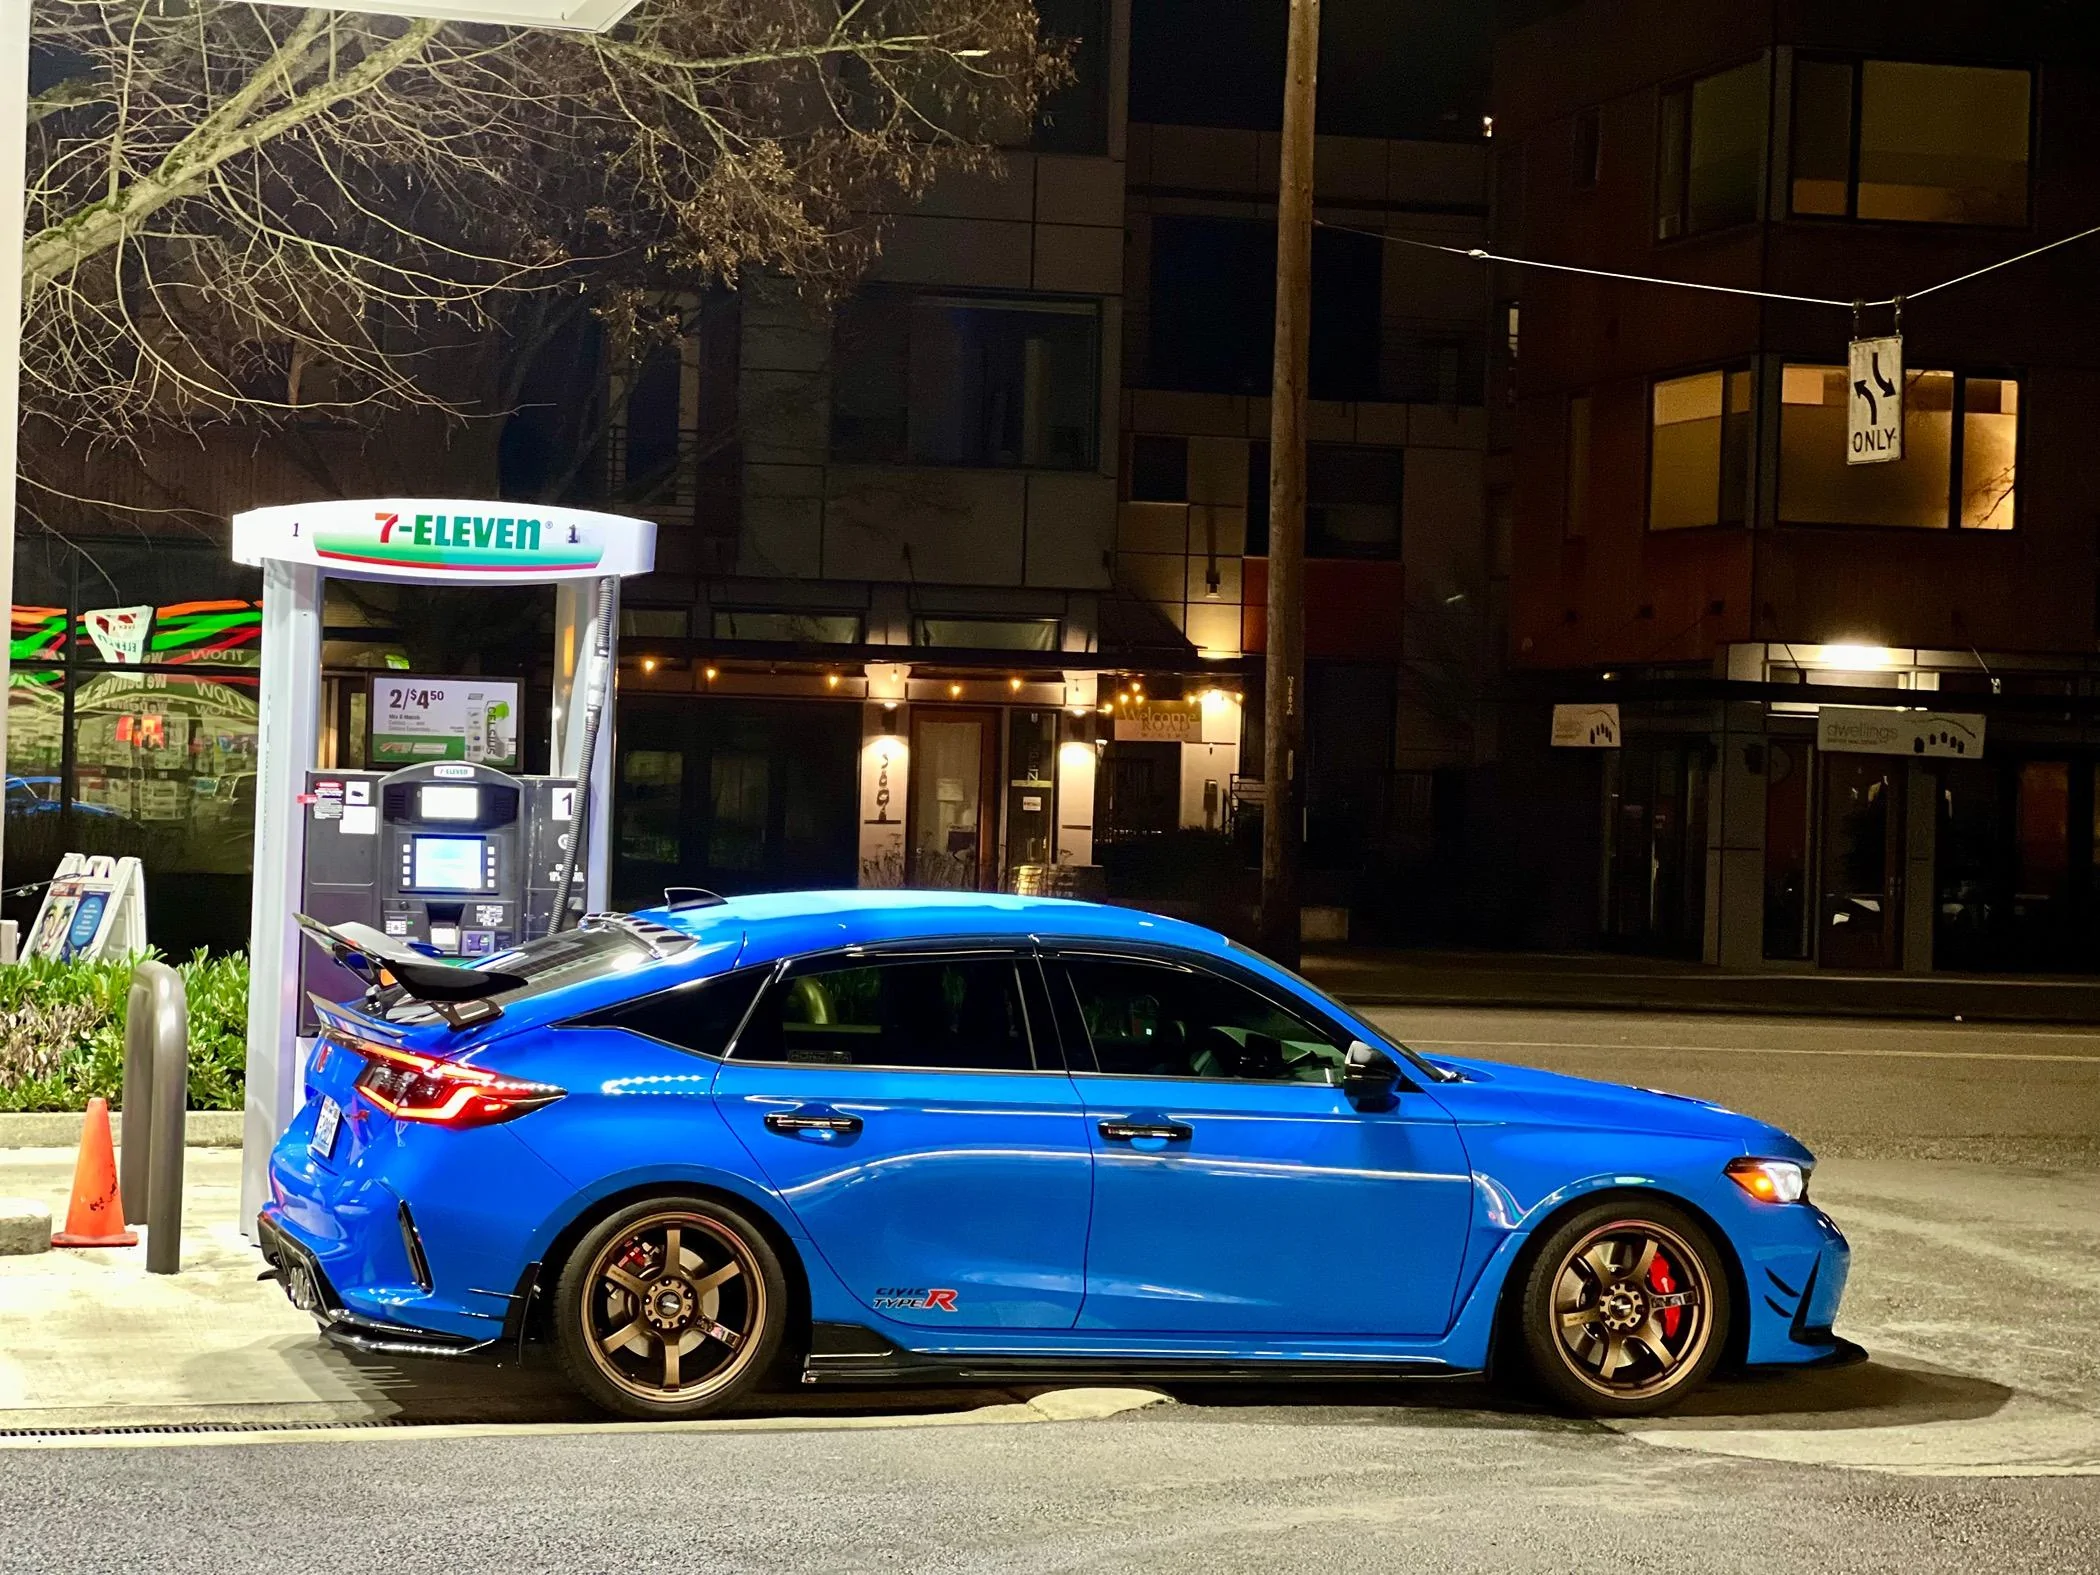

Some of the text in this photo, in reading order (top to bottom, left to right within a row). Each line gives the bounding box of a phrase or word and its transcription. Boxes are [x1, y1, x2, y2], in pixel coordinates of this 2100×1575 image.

[1853, 428, 1896, 453] ONLY
[567, 524, 579, 543] 1
[1121, 706, 1196, 722] Welcome
[1827, 722, 1898, 743] dwellings
[562, 792, 572, 816] 1
[873, 1288, 958, 1312] TYPE R
[876, 1288, 926, 1297] CIVIC
